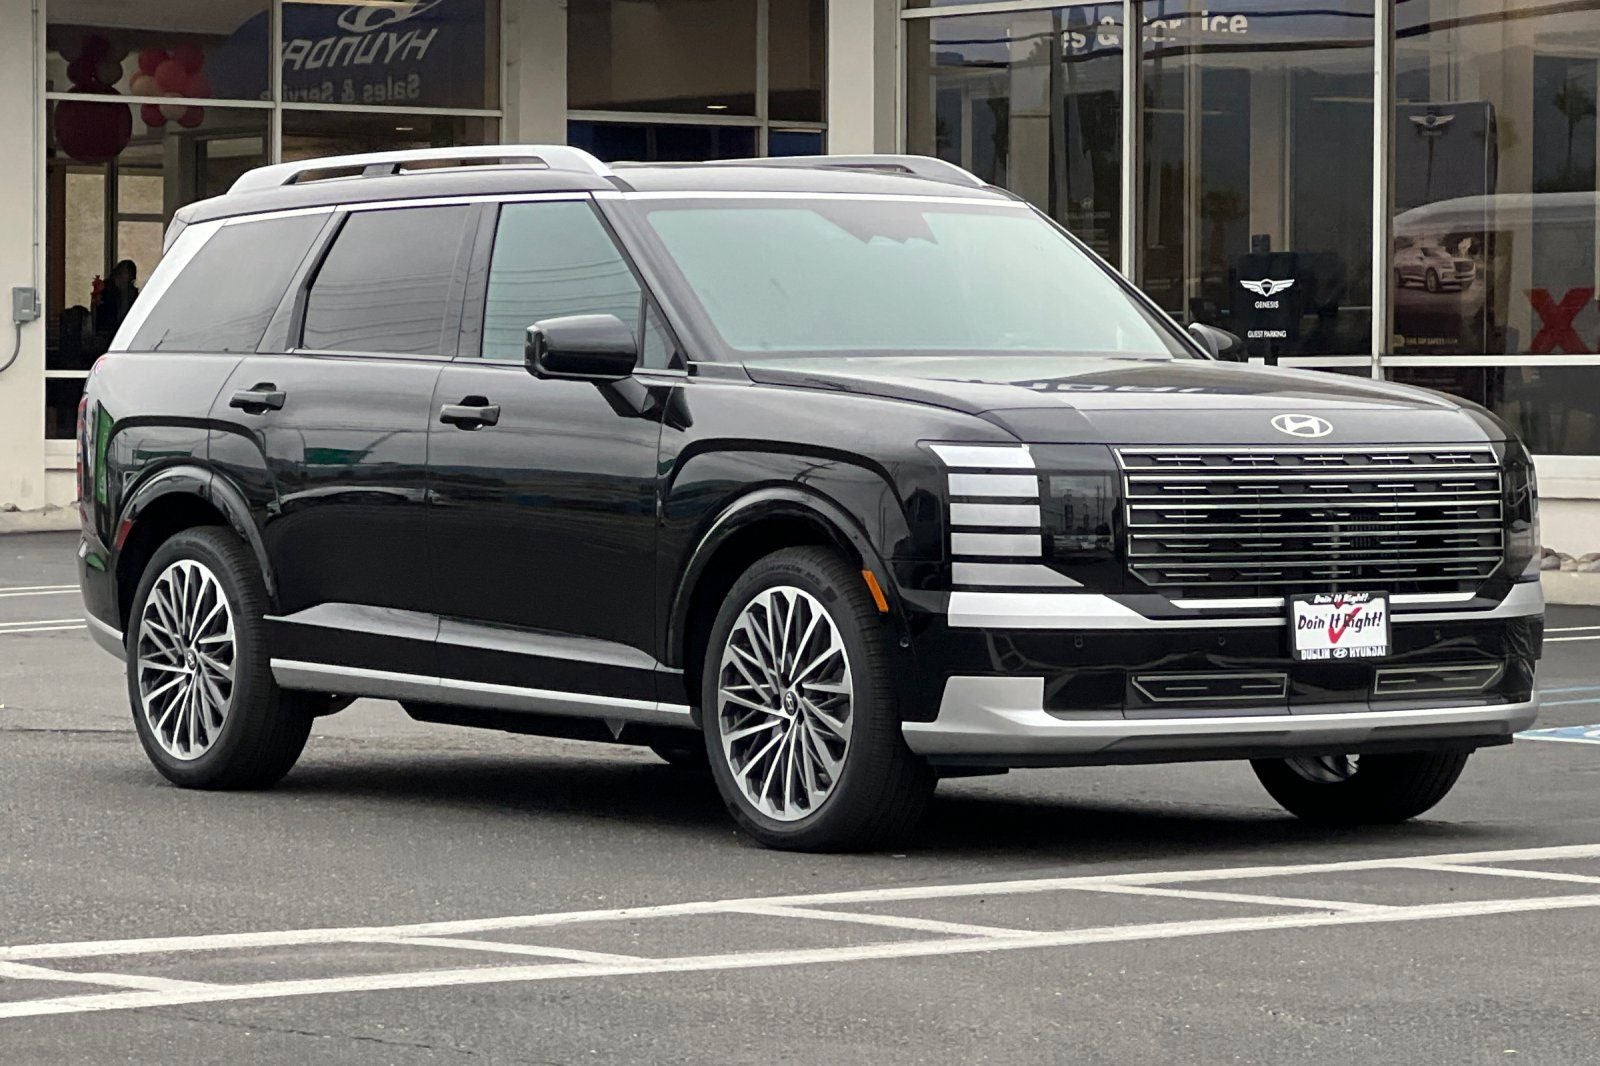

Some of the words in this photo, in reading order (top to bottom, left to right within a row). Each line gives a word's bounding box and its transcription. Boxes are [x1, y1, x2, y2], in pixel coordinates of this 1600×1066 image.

[1254, 300, 1279, 309] GENESIS
[1247, 330, 1264, 338] GUEST
[1263, 330, 1287, 338] PARKING
[1330, 613, 1340, 629] It
[1343, 611, 1383, 633] Right!
[1349, 645, 1386, 657] HYUNDAI
